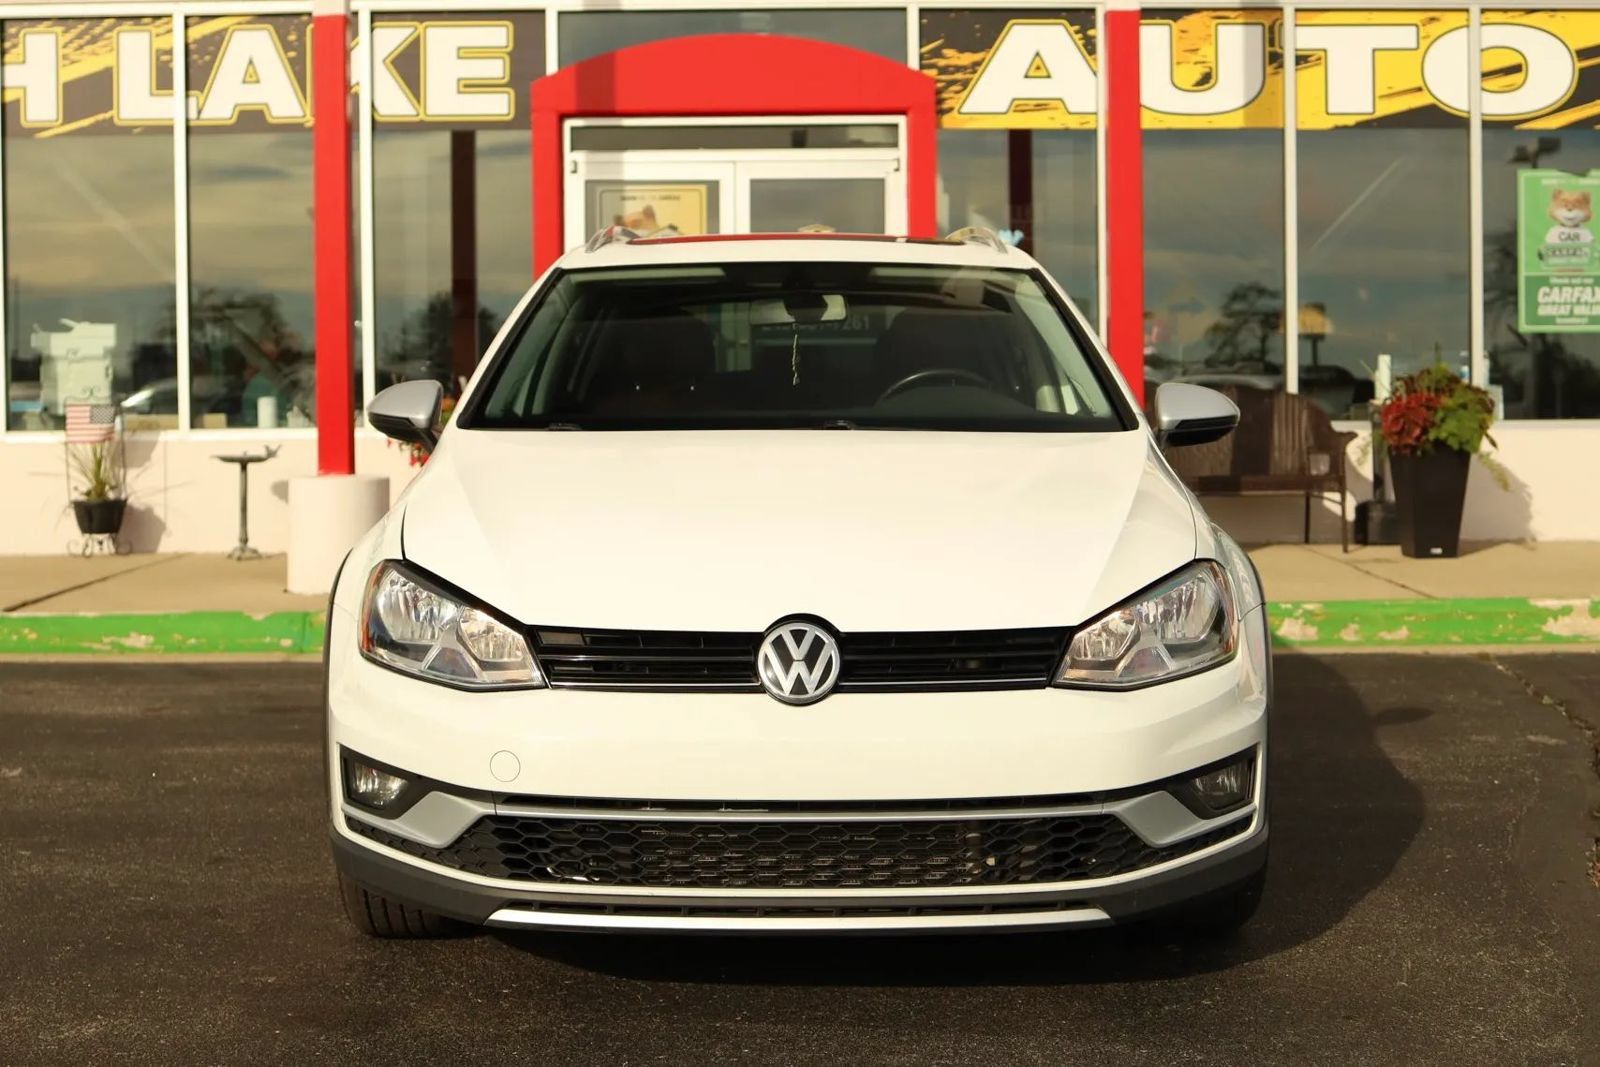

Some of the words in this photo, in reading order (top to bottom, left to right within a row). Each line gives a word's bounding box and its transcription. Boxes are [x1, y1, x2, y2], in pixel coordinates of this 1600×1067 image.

[112, 20, 515, 126] LAKE
[953, 18, 1580, 120] AUTO
[1558, 231, 1581, 242] CAR
[759, 622, 839, 702] VW
